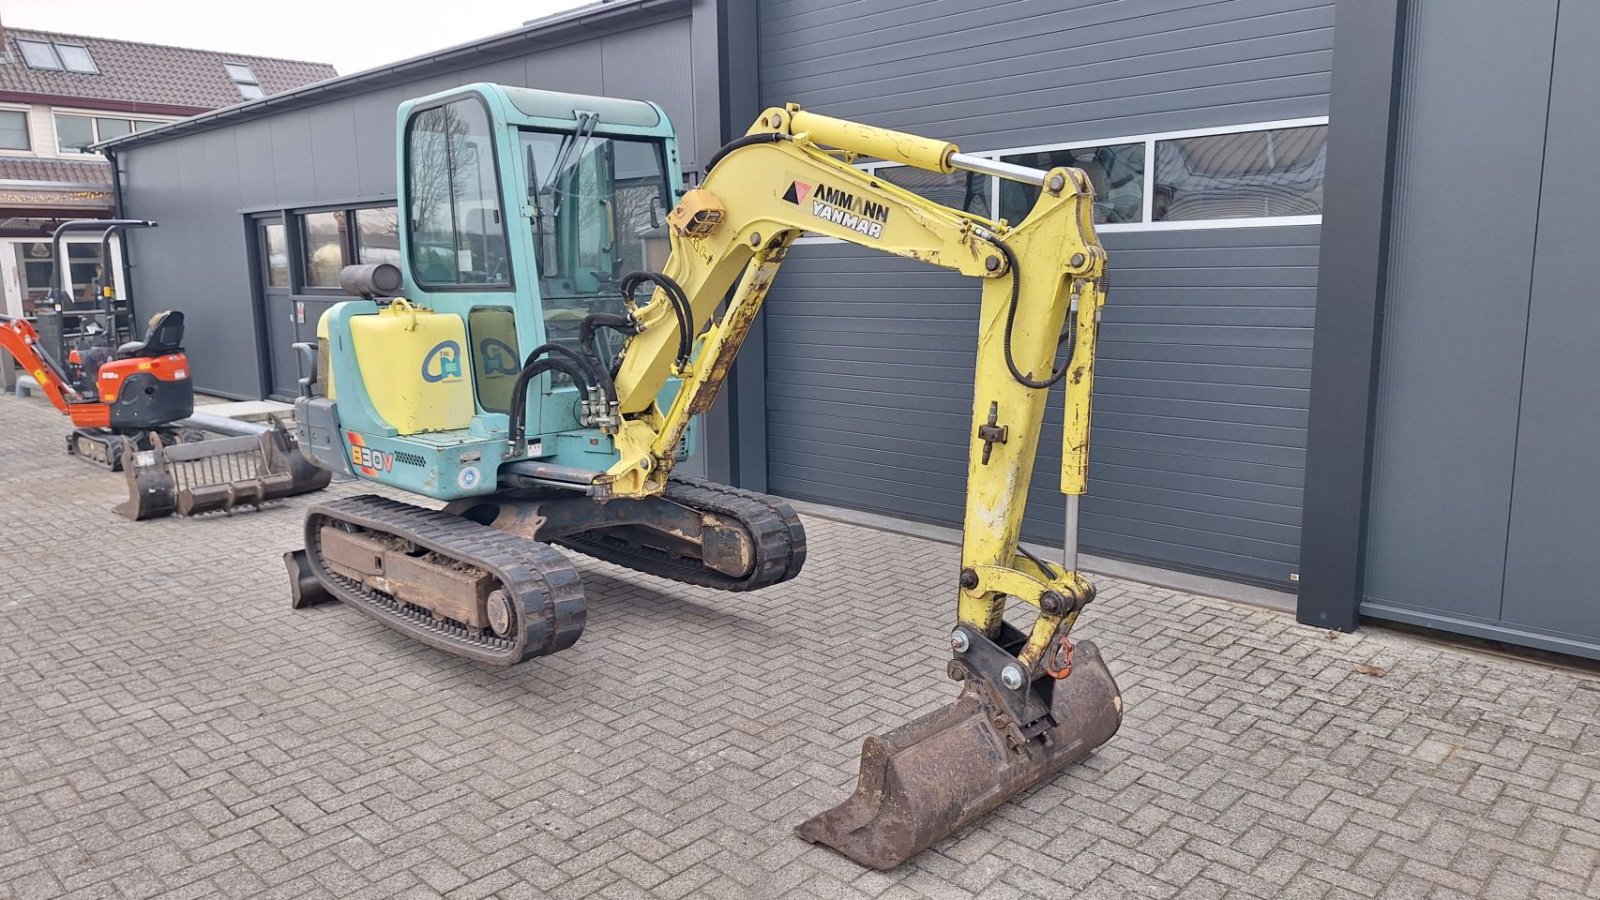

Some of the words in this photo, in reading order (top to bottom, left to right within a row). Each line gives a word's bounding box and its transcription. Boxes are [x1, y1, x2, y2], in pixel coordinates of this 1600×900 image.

[812, 200, 883, 239] YANMAR
[813, 183, 890, 223] AMMANN
[351, 444, 394, 473] B30V
